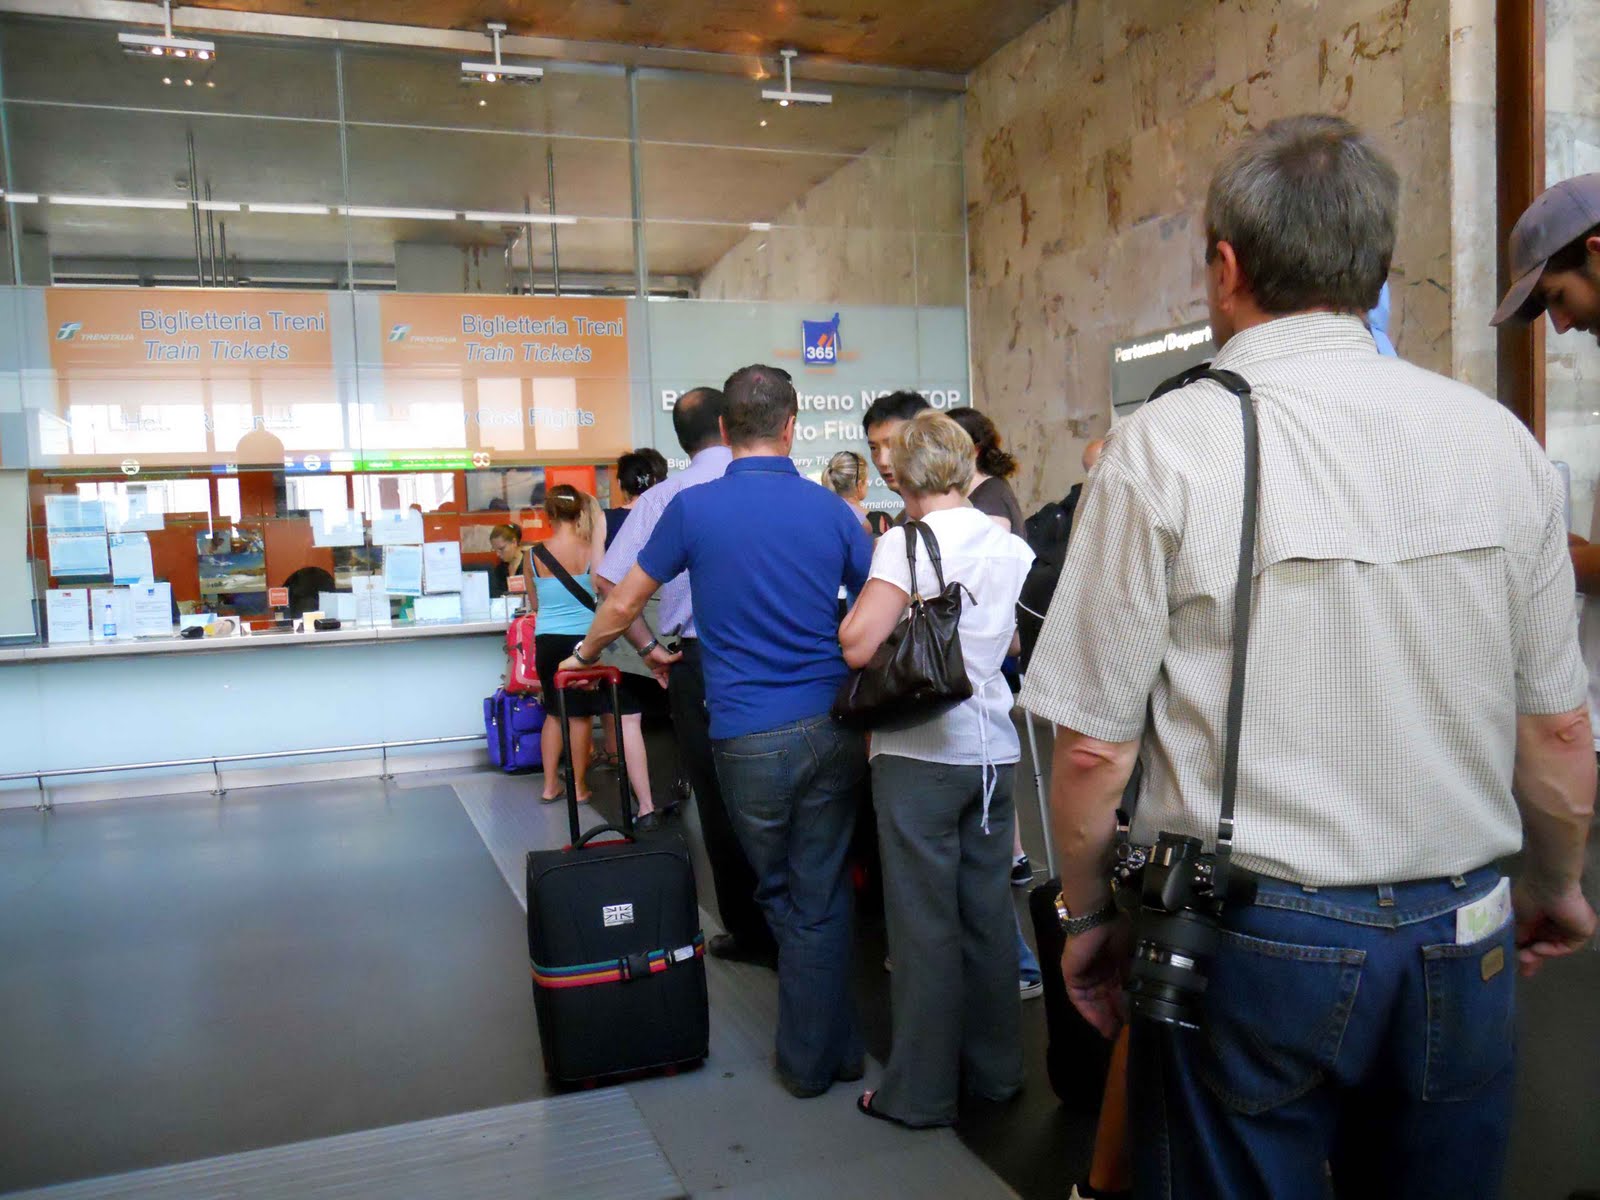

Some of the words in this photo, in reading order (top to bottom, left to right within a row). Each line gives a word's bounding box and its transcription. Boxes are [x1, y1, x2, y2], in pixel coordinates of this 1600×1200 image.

[139, 310, 262, 336] Biglietteria
[269, 311, 325, 331] Treni
[462, 314, 569, 337] Biglietteria
[573, 317, 623, 336] Treni
[144, 340, 200, 361] Train
[210, 340, 289, 360] Tickets
[464, 342, 515, 362] Train
[523, 343, 592, 362] Tickets
[806, 346, 834, 360] 365
[797, 390, 854, 410] treno
[528, 408, 595, 431] Flights
[795, 422, 816, 441] to
[824, 420, 866, 441] Fiu
